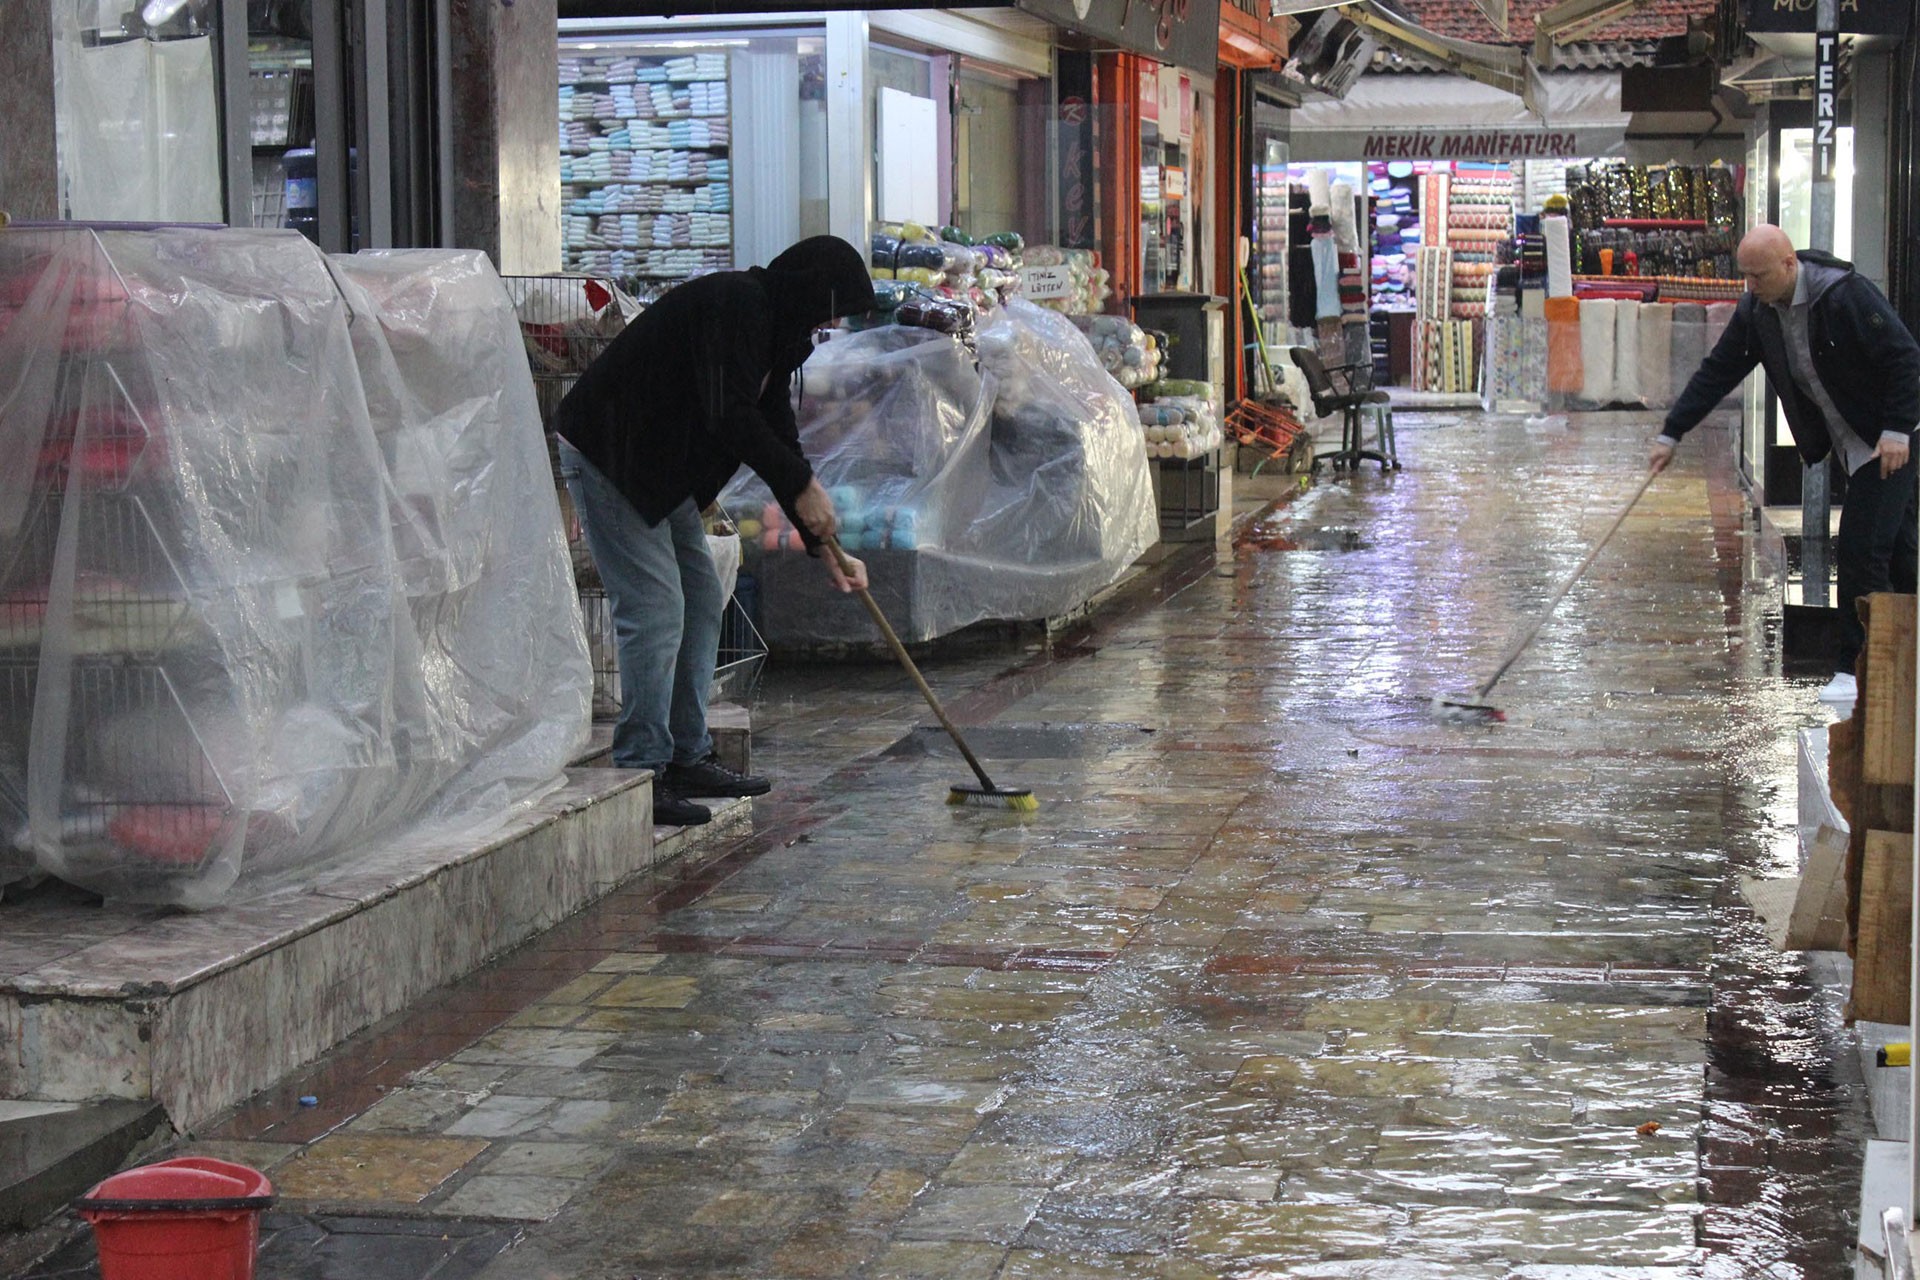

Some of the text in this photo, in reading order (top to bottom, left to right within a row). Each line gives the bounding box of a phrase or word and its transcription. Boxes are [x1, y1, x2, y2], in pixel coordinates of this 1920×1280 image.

[1363, 130, 1577, 158] MEKİK MANİFATURA
[1817, 37, 1834, 176] TERZİ
